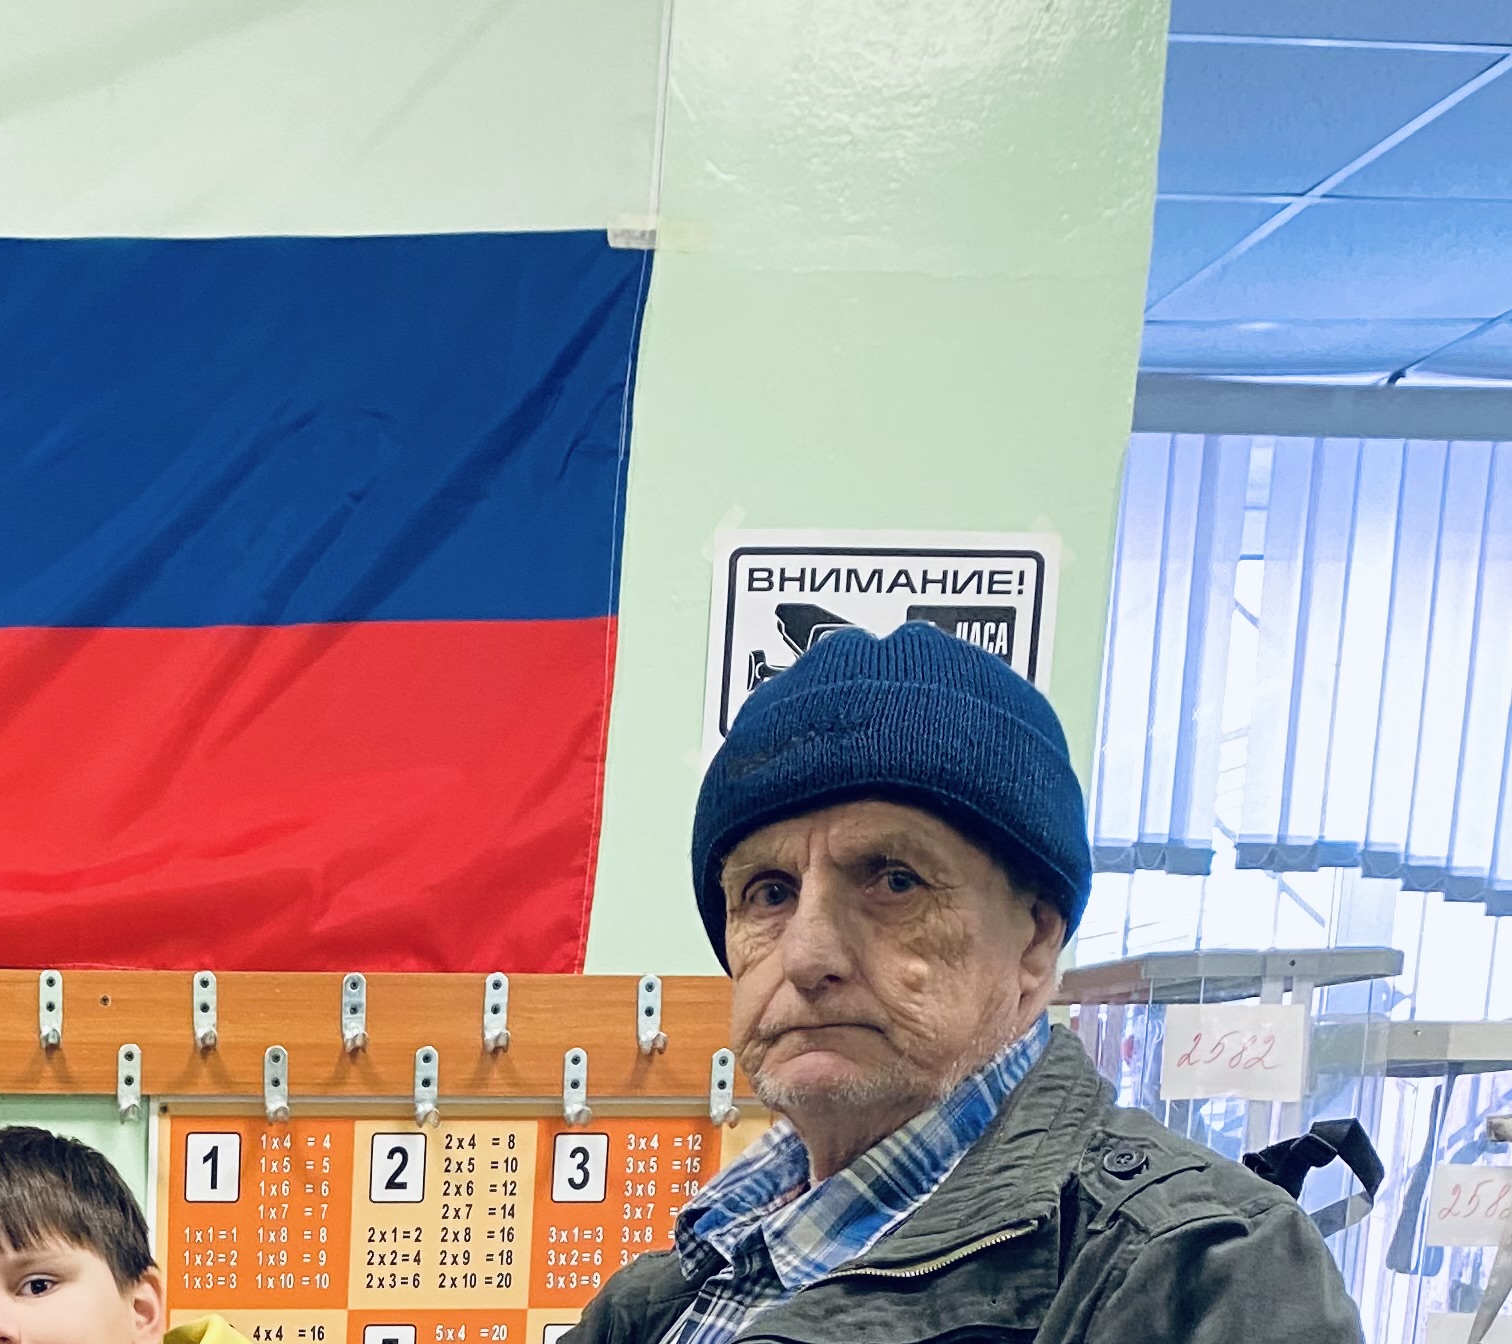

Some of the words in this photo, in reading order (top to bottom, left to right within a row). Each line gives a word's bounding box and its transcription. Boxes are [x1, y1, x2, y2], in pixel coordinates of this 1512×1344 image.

[746, 566, 1027, 596] ВНИМАНИЕ!
[1175, 1030, 1285, 1071] 2582
[261, 1133, 267, 1150] 1
[283, 1133, 292, 1149] 4
[322, 1133, 331, 1150] 4
[444, 1133, 453, 1150] 2
[467, 1133, 477, 1150] 4
[507, 1133, 516, 1150] 8
[627, 1133, 636, 1151] 3
[649, 1133, 659, 1150] 4
[686, 1134, 702, 1151] 12
[202, 1144, 219, 1191] 1
[384, 1145, 409, 1191] 2
[443, 1156, 452, 1174] 2
[467, 1157, 475, 1174] 5
[503, 1156, 519, 1173] 10
[566, 1145, 591, 1191] 3
[625, 1156, 634, 1174] 3
[649, 1156, 658, 1174] 5
[685, 1156, 701, 1174] 15
[258, 1203, 265, 1220] 1
[281, 1203, 289, 1220] 7
[320, 1203, 329, 1220] 7
[184, 1226, 190, 1243] 1
[207, 1226, 214, 1243] 1
[231, 1226, 237, 1243] 1
[367, 1226, 376, 1243] 2
[391, 1226, 398, 1243] 1
[414, 1226, 423, 1243] 2
[440, 1226, 449, 1243] 2
[463, 1226, 472, 1243] 8
[499, 1226, 515, 1243] 16
[548, 1226, 557, 1243] 3
[572, 1226, 579, 1243] 1
[595, 1226, 604, 1243] 3
[366, 1249, 375, 1266] 2
[389, 1249, 398, 1266] 2
[412, 1249, 421, 1266] 4
[547, 1249, 556, 1266] 3
[569, 1249, 579, 1266] 2
[593, 1248, 603, 1266] 6
[183, 1272, 189, 1289] 1
[205, 1272, 214, 1289] 3
[229, 1272, 237, 1289] 3
[255, 1273, 262, 1289] 1
[279, 1272, 294, 1289] 10
[314, 1272, 330, 1289] 10
[438, 1272, 447, 1289] 2
[462, 1272, 477, 1289] 10
[496, 1272, 512, 1289] 20
[545, 1272, 555, 1289] 3
[569, 1272, 577, 1289] 3
[591, 1272, 601, 1289] 9
[252, 1325, 261, 1342] 4
[275, 1325, 284, 1342] 4
[310, 1325, 325, 1342] 16
[435, 1324, 444, 1342] 5
[457, 1324, 466, 1341] 4
[491, 1324, 508, 1341] 20
